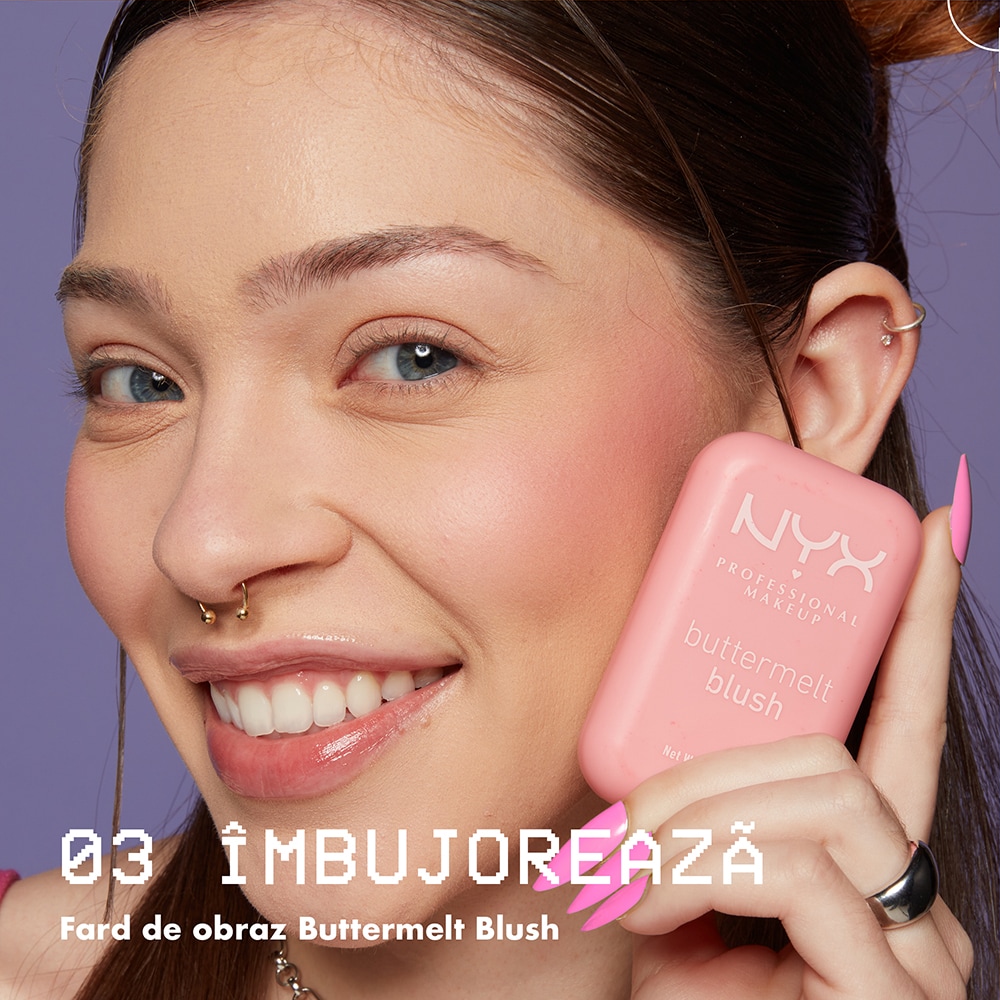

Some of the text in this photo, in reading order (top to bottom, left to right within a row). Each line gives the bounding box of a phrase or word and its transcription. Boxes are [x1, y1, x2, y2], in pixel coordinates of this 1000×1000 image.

[730, 492, 887, 593] NYX
[715, 556, 859, 628] PROFESSIONAL
[743, 585, 823, 625] MAKEUP
[683, 619, 834, 704] buttermelt
[704, 666, 784, 721] blush
[662, 744, 681, 761] Net
